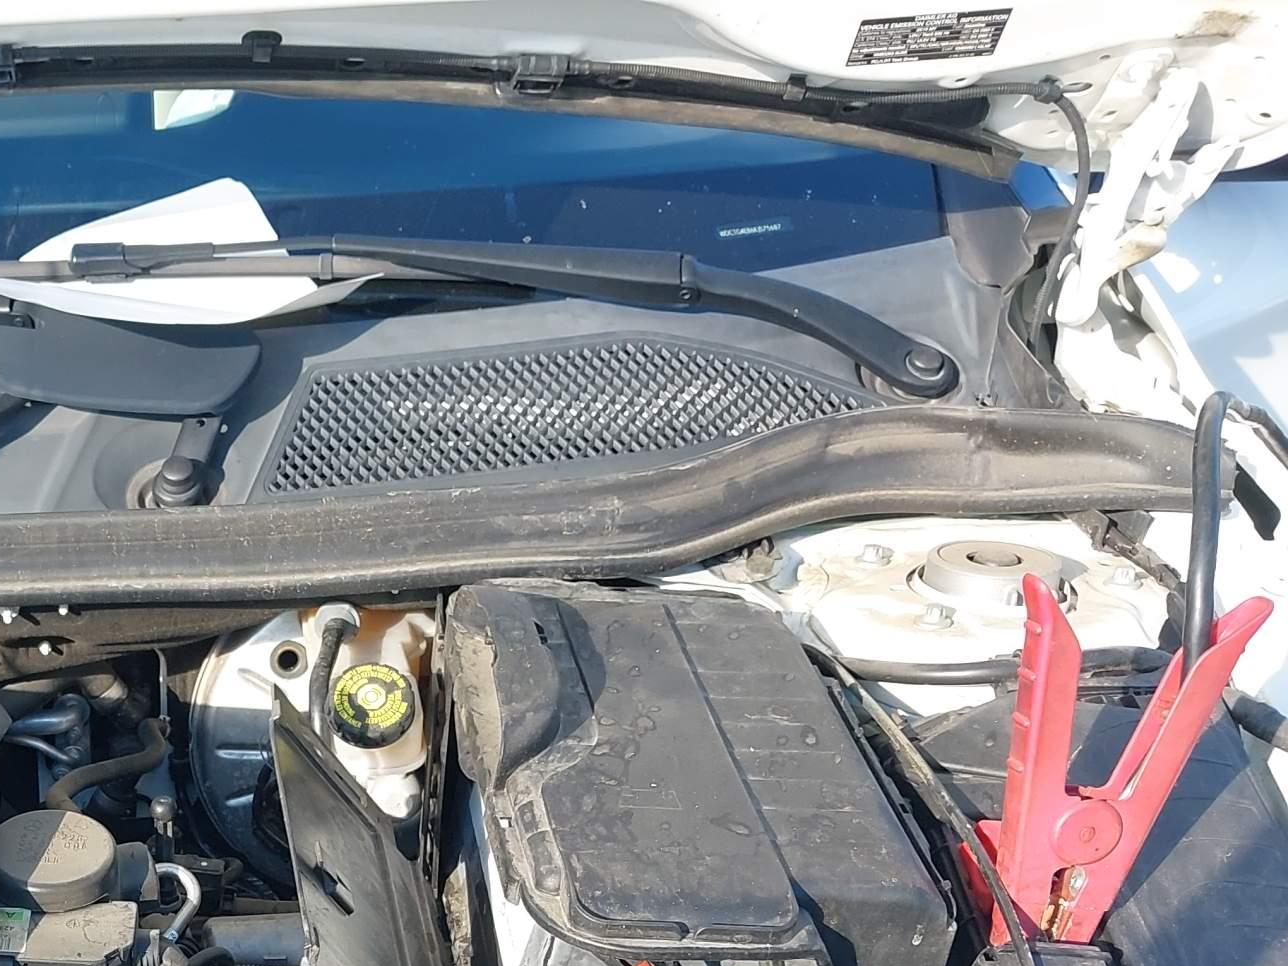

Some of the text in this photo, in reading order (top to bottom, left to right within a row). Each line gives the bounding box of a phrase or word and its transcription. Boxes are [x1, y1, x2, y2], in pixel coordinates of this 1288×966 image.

[914, 13, 947, 21] DAIMLER
[860, 14, 1009, 31] VEHICLE EMISSION CONTROL INFORMATION
[6, 911, 17, 919] A
